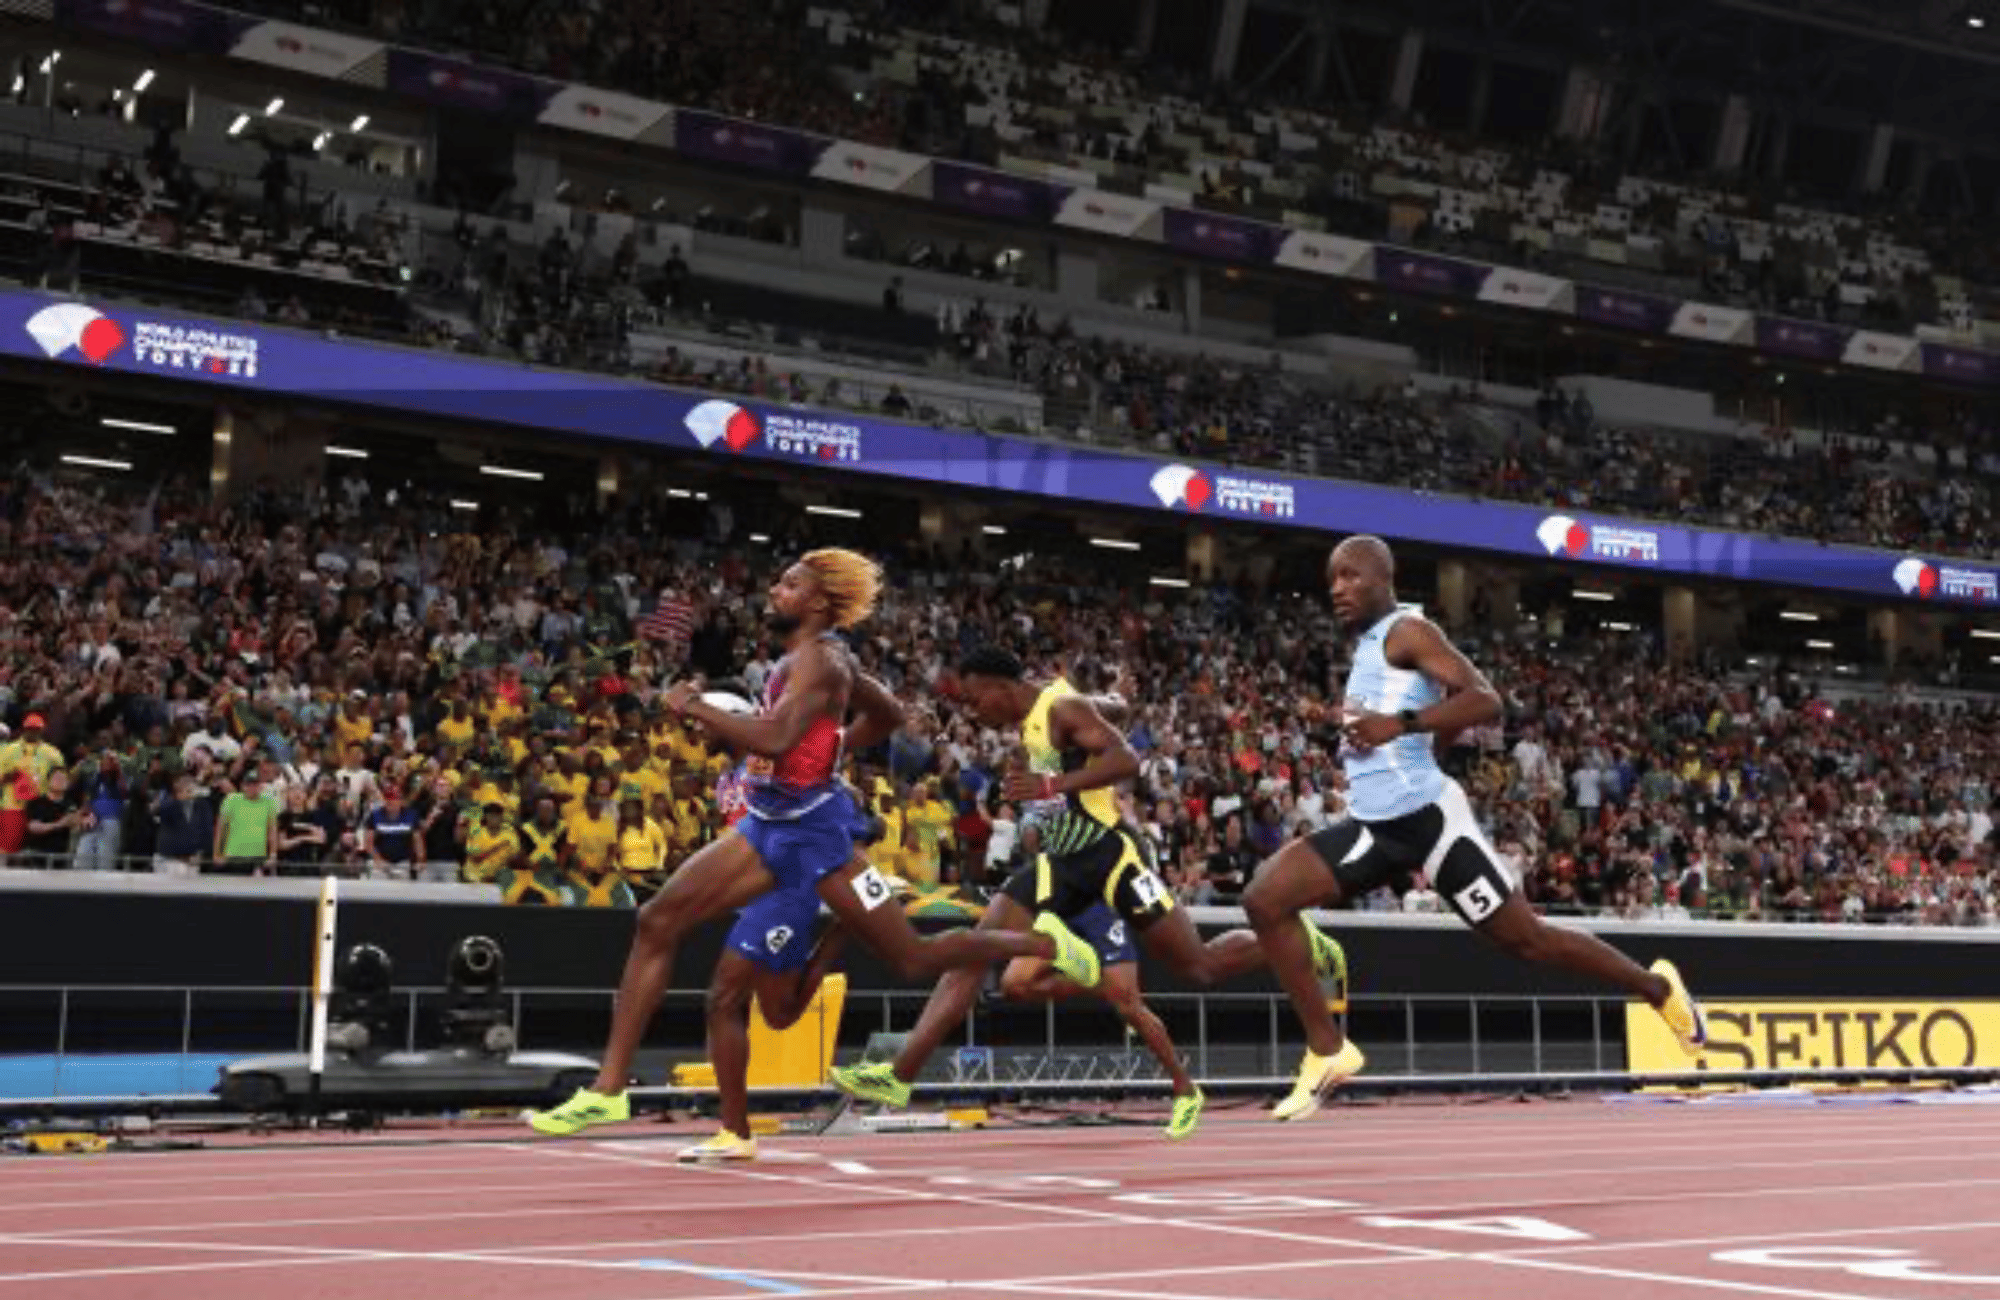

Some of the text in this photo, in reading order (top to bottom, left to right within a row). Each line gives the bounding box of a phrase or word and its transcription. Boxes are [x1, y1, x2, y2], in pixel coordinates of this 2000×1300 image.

[864, 873, 884, 899] 6
[1468, 888, 1491, 914] 5
[1695, 1009, 1977, 1069] SEIKO
